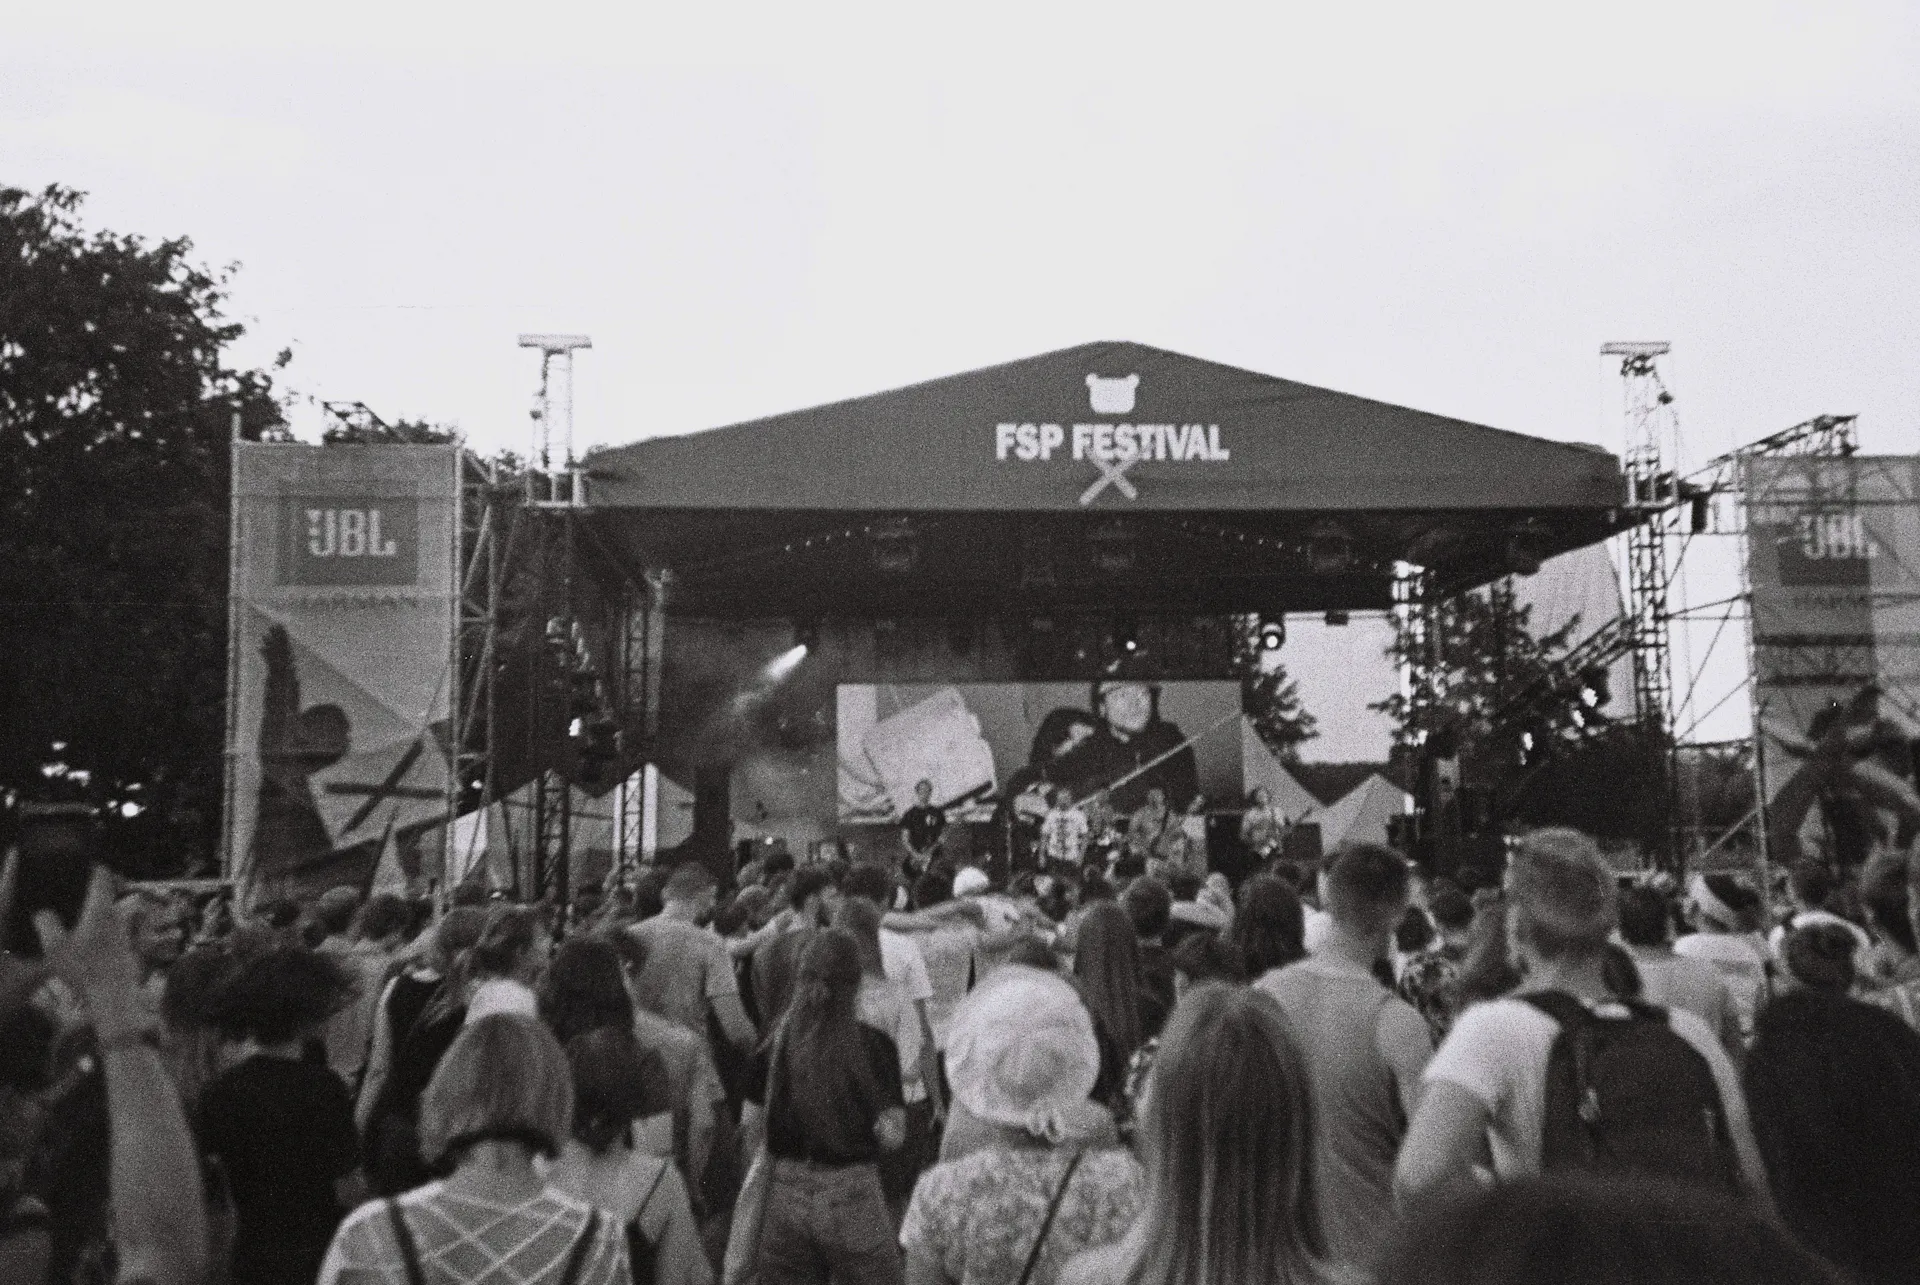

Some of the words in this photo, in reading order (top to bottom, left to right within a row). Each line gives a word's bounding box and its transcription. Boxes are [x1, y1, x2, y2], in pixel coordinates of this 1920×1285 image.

[995, 423, 1065, 460] FSP
[1072, 423, 1230, 461] FESTIVAL
[306, 509, 398, 557] JBL
